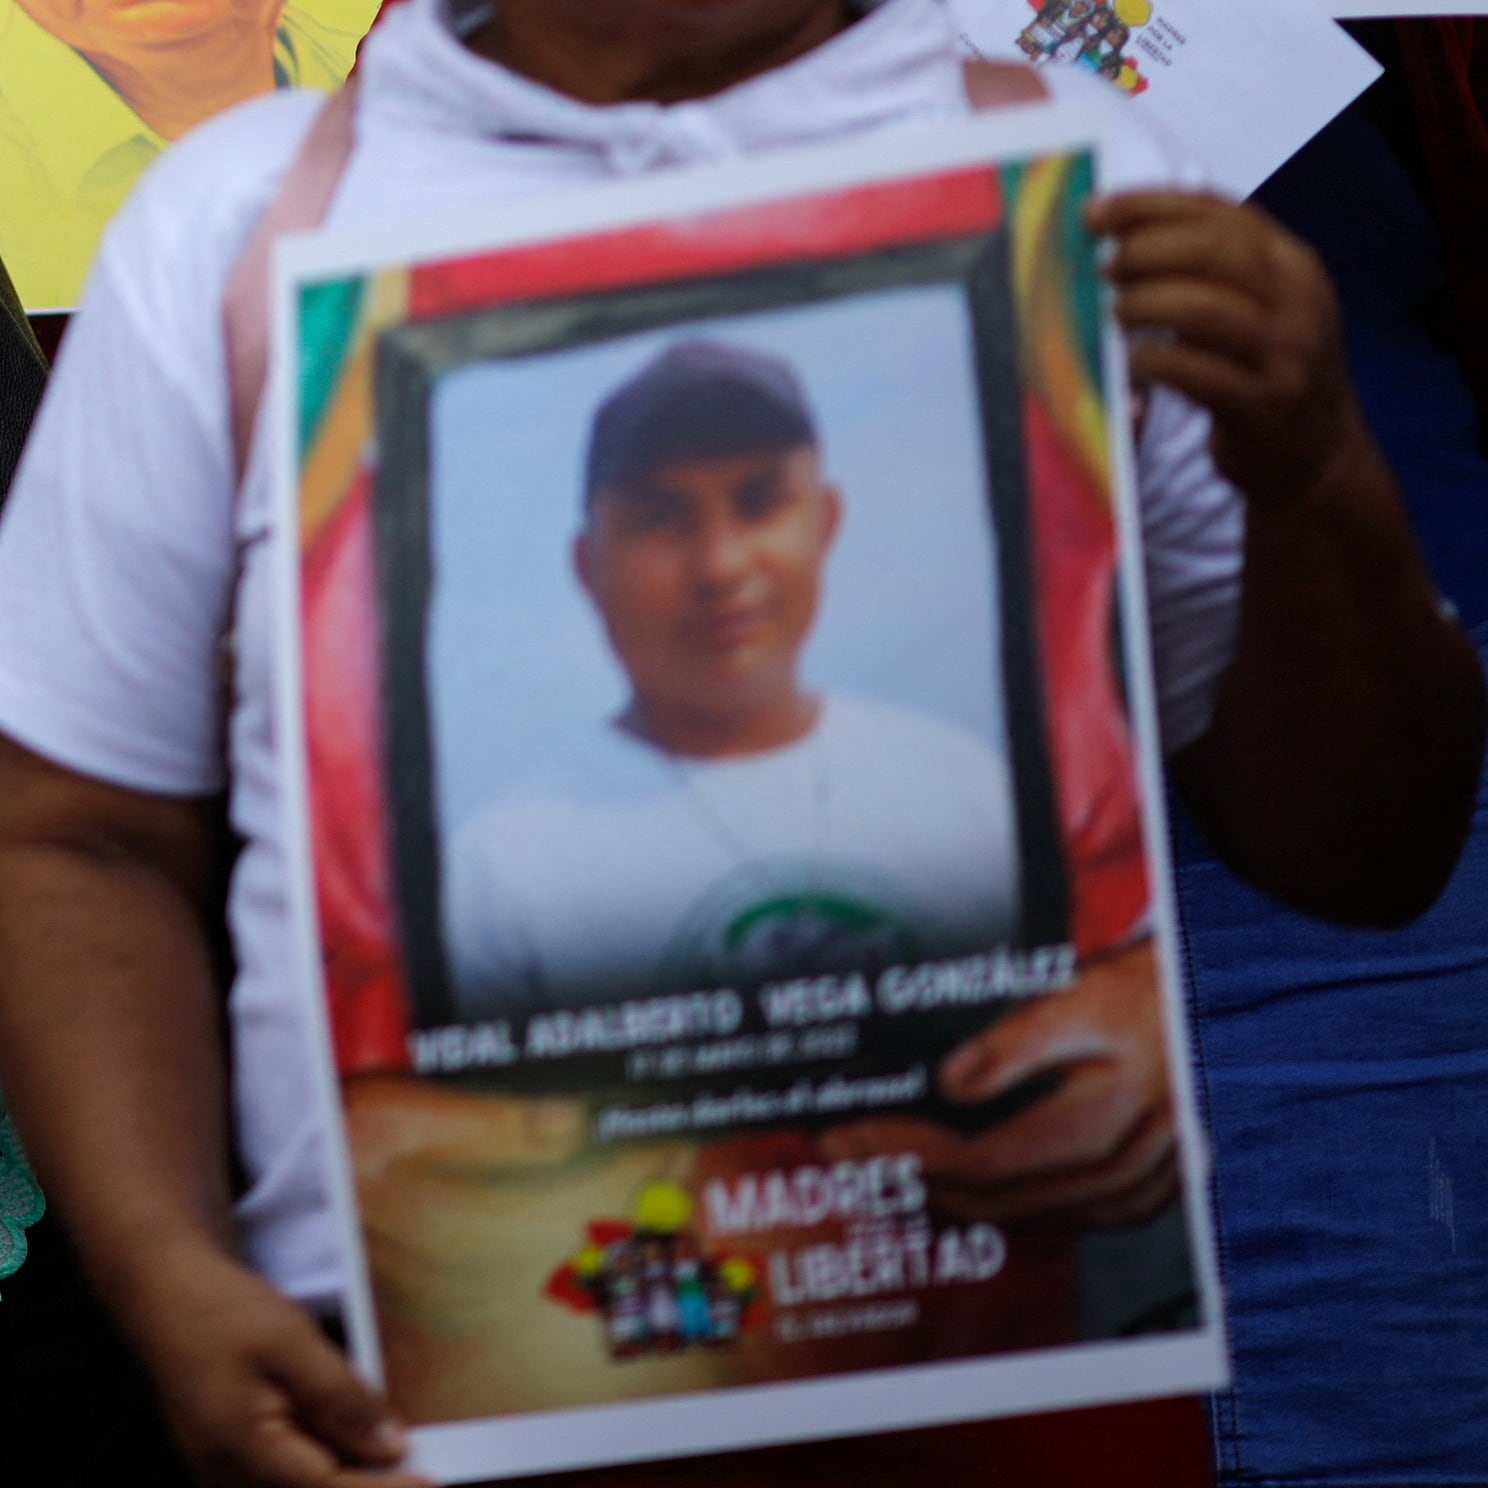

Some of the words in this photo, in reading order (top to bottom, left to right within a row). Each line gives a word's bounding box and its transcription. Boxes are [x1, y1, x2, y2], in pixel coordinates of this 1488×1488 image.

[409, 1023, 518, 1073] VIDAL
[525, 989, 741, 1059] ADALBERTO
[759, 971, 872, 1024] VEGA
[704, 1152, 927, 1235] MADRES
[768, 1221, 1008, 1305] LIBERTAD
